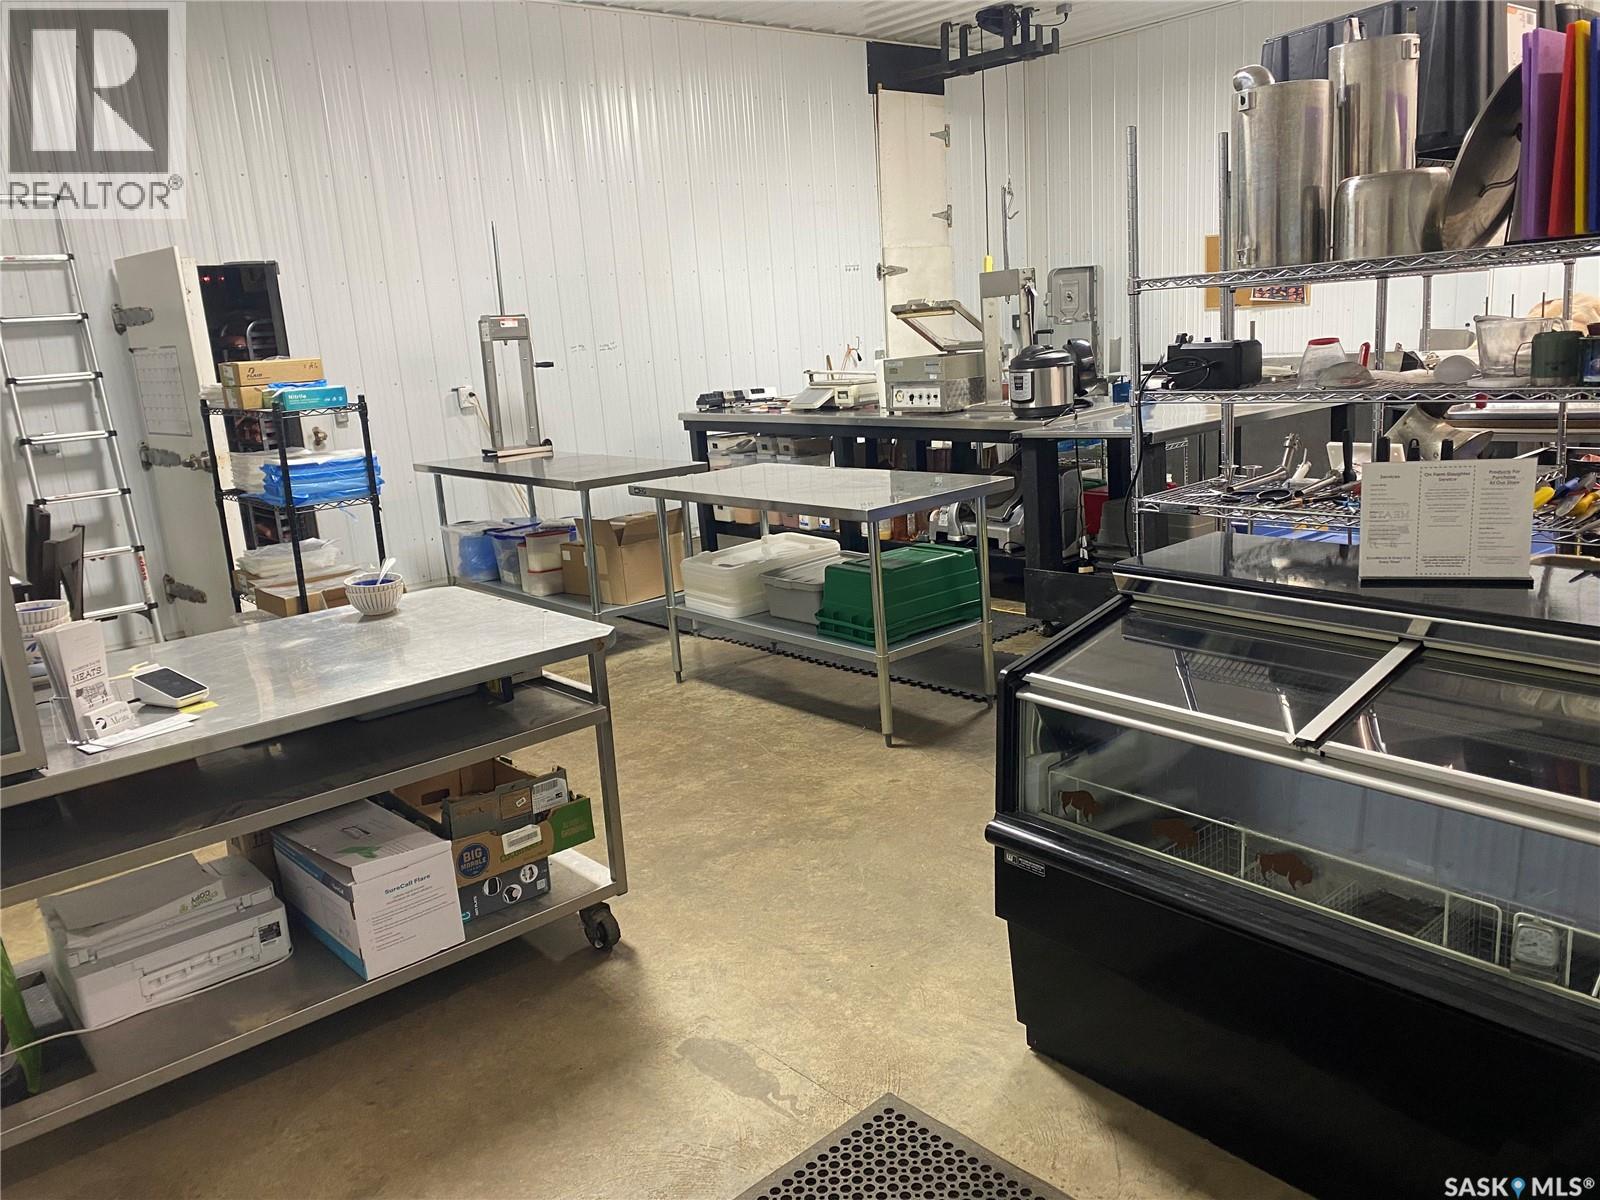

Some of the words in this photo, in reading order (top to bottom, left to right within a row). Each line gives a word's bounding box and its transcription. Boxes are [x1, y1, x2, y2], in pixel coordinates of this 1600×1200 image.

[72, 666, 102, 684] MEATS
[463, 848, 483, 862] BIG
[384, 880, 413, 895] SureCall
[414, 874, 431, 884] Flare
